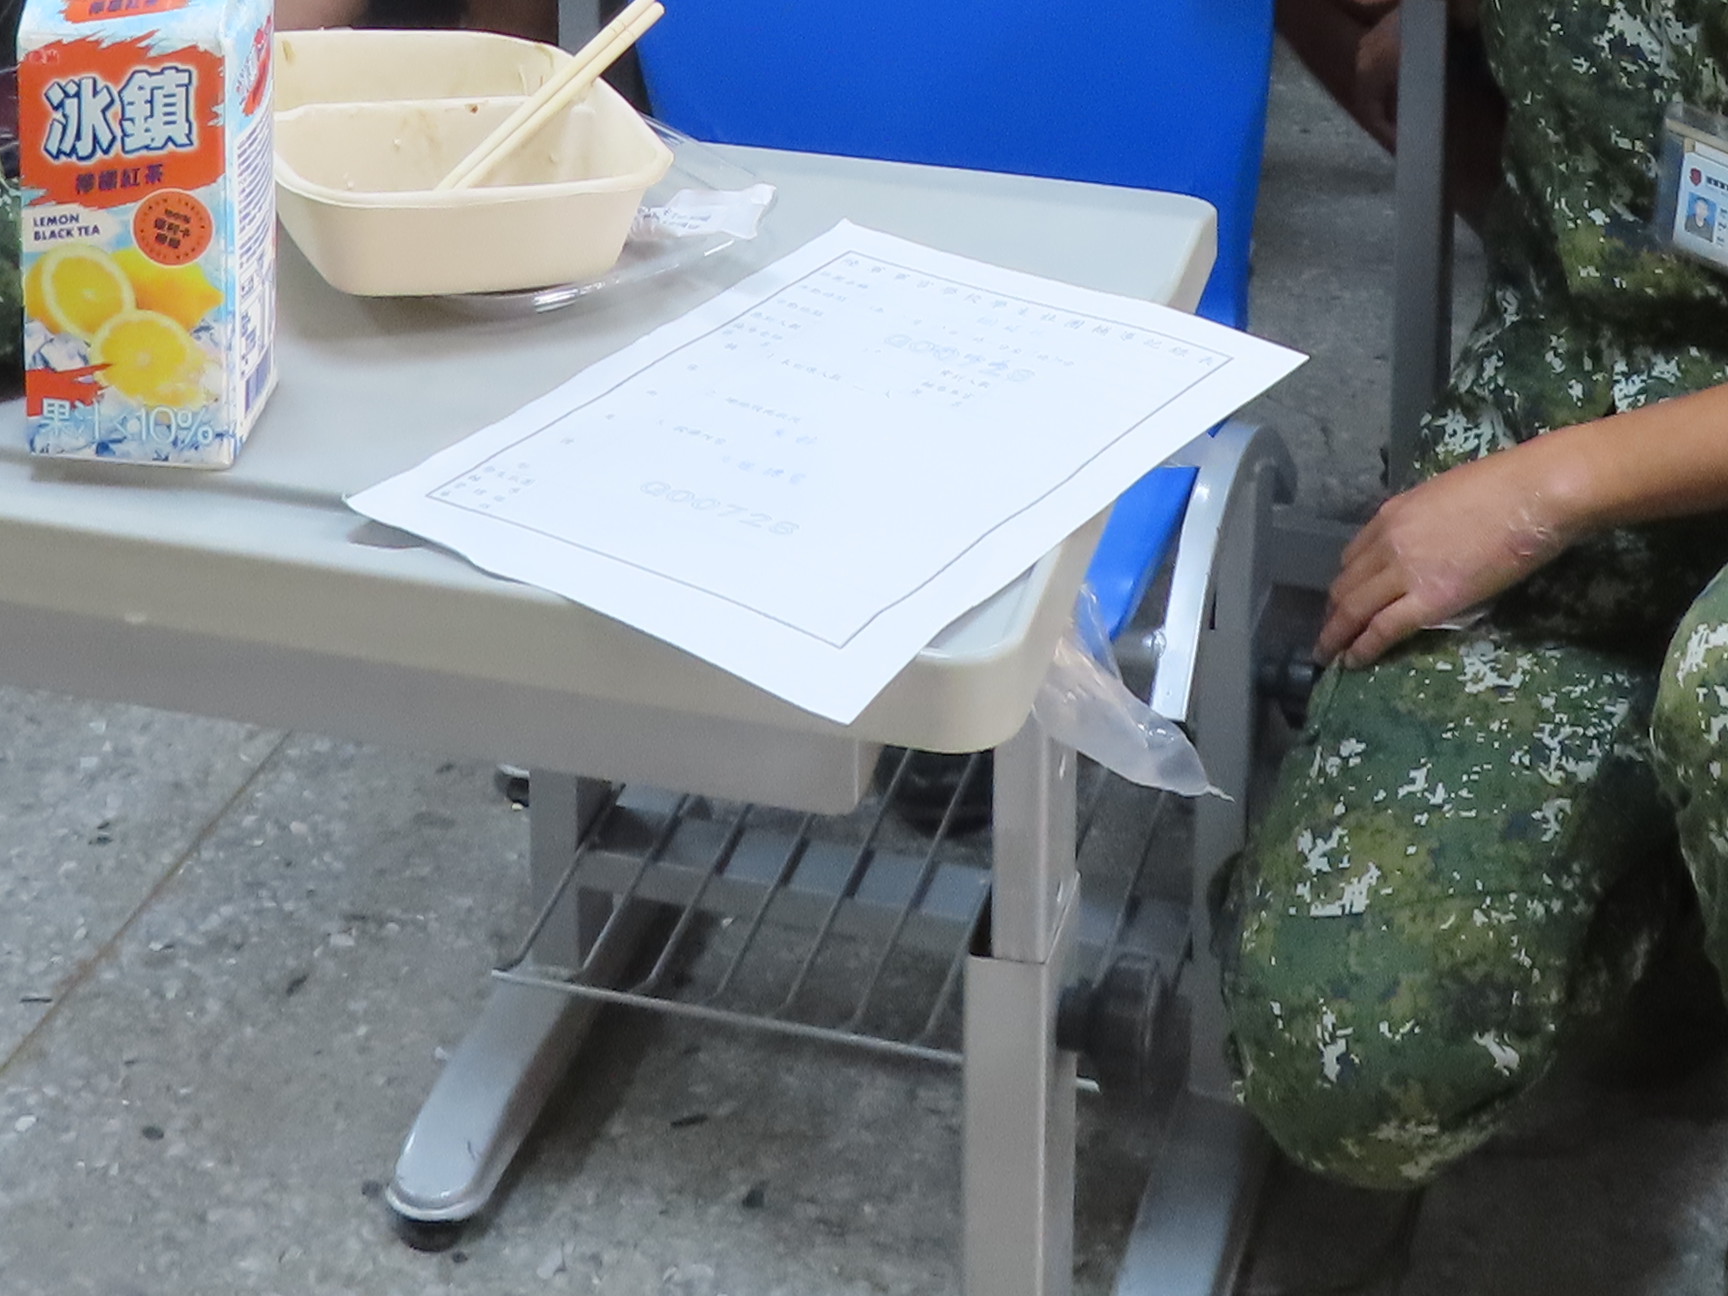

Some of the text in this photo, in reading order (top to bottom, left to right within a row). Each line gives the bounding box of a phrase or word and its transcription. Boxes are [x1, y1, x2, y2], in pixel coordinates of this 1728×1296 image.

[43, 66, 195, 161] 冰鎮
[33, 212, 80, 228] LEMON
[33, 224, 101, 242] BLACK TEA
